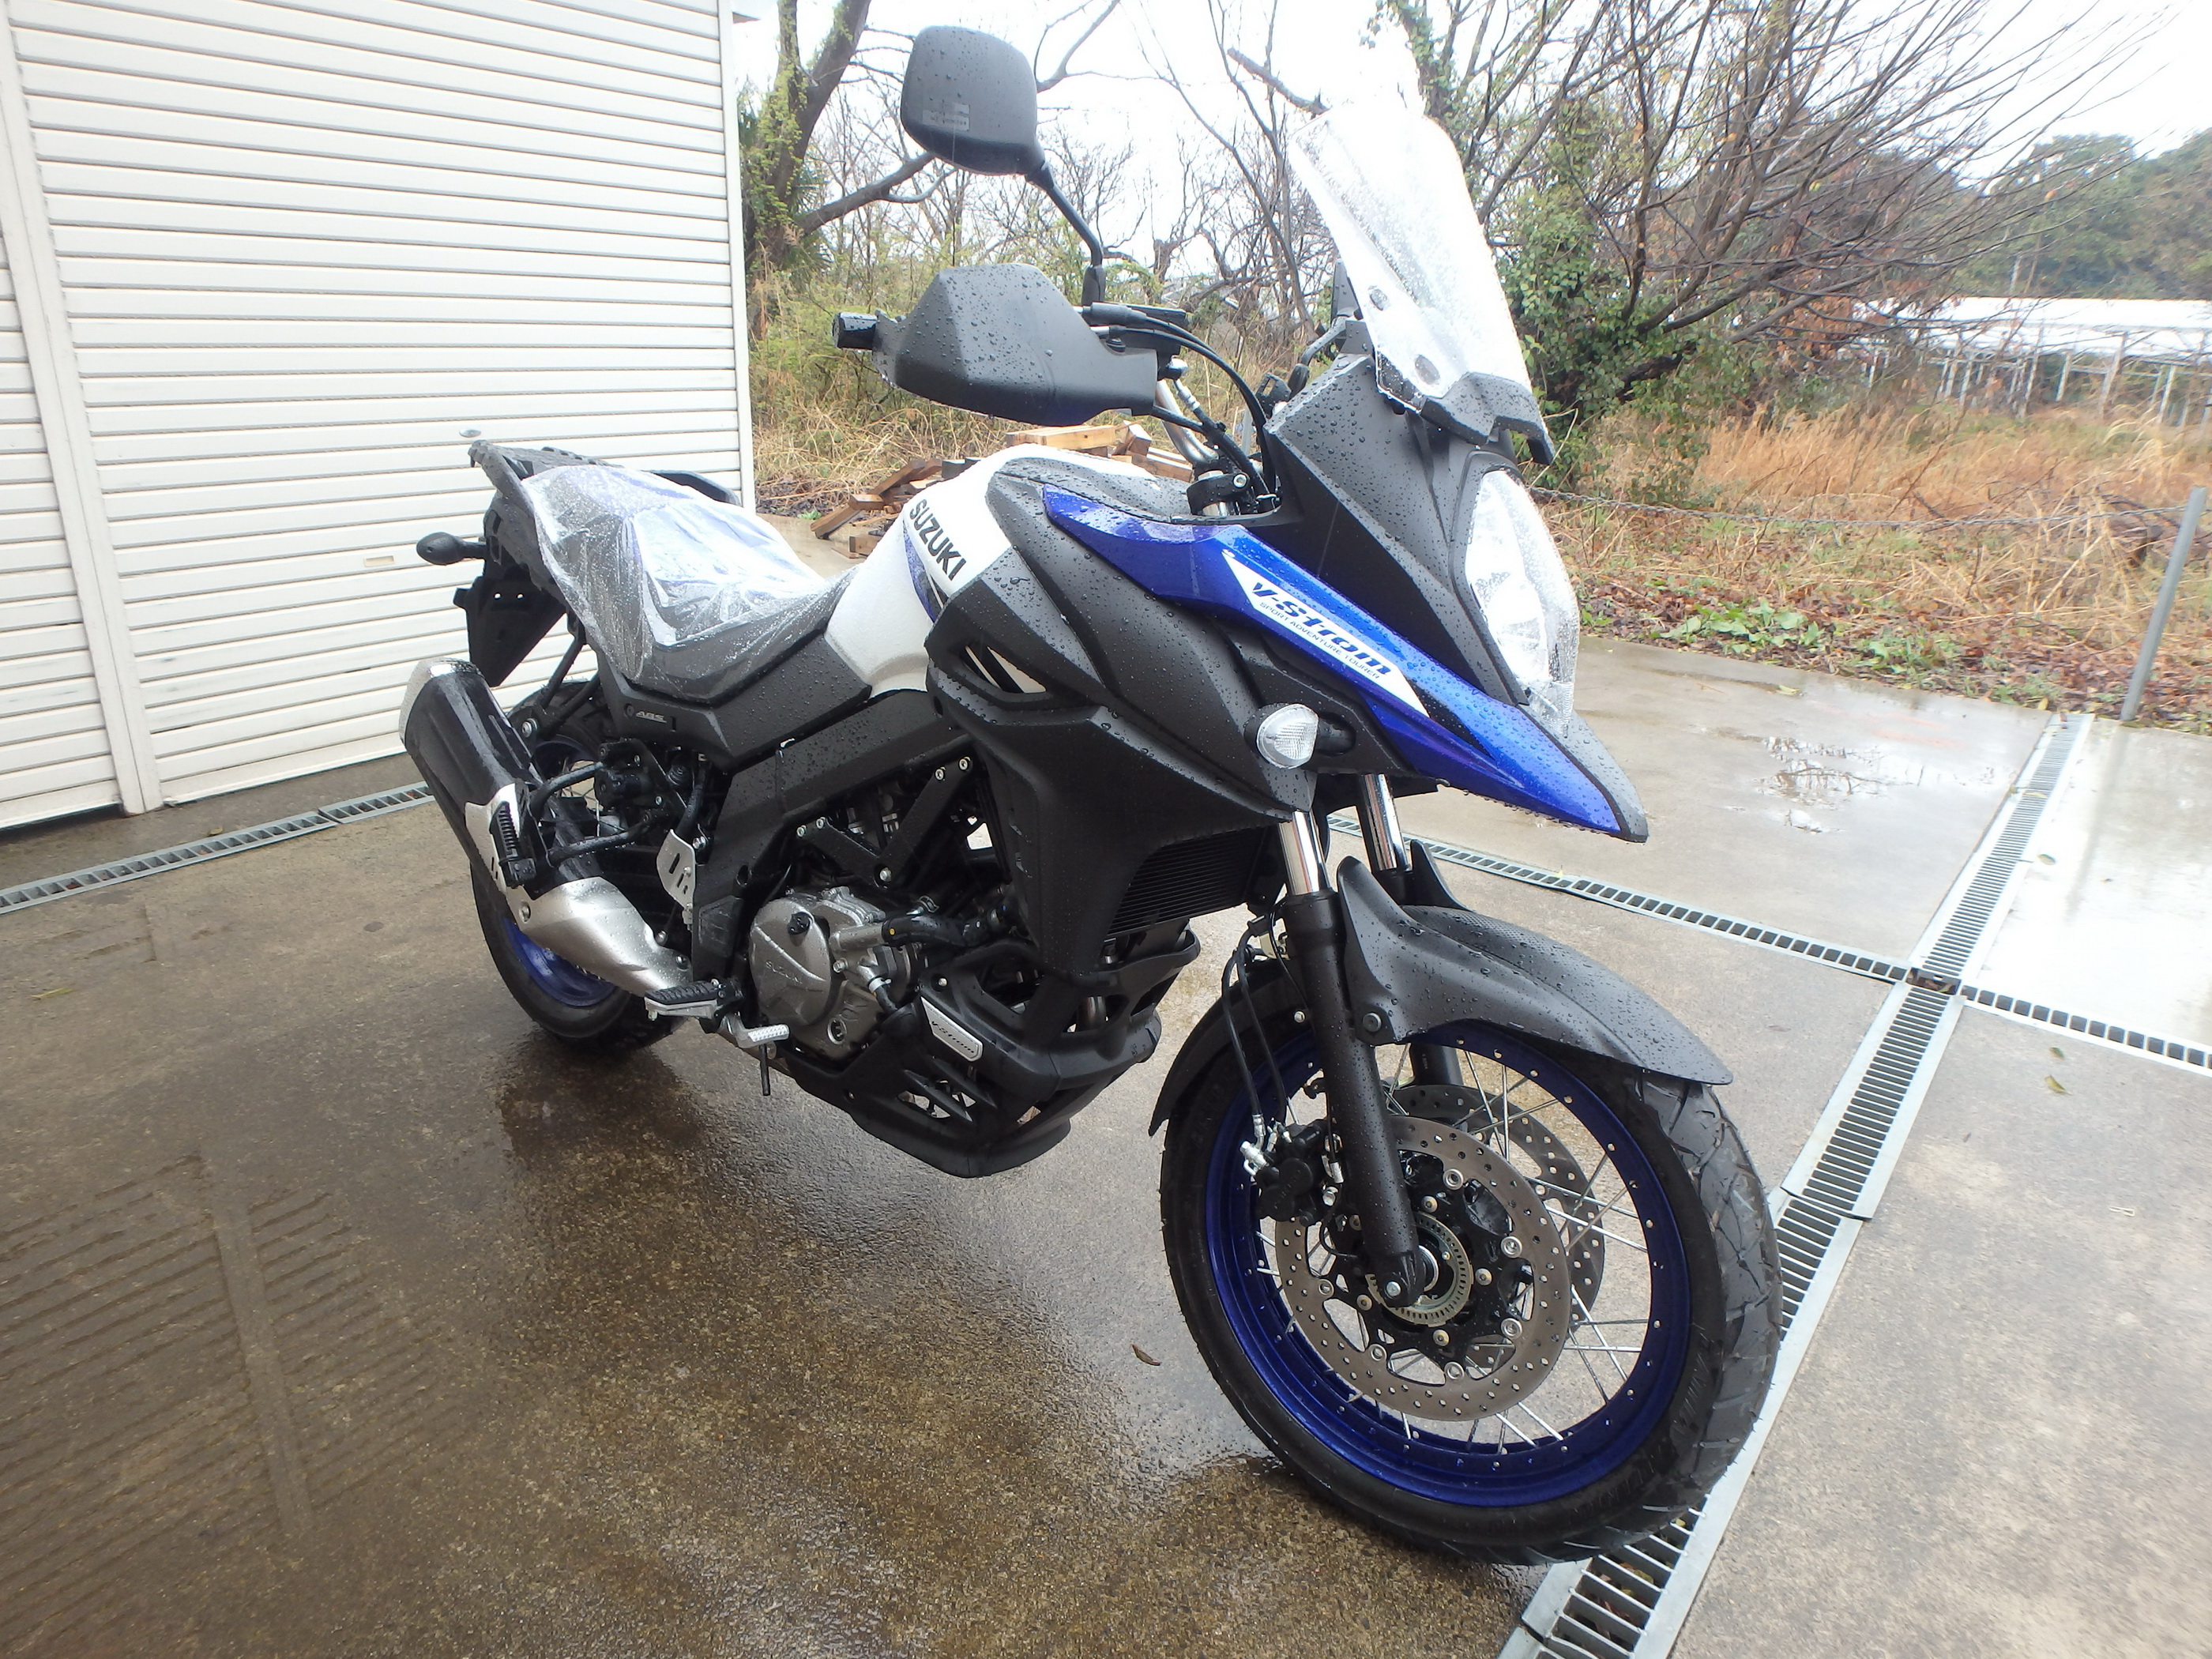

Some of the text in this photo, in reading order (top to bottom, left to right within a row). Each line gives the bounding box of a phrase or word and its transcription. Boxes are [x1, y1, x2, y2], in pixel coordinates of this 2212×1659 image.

[909, 498, 967, 581] SUZUKI
[1251, 582, 1392, 675] V-Strom
[1259, 602, 1380, 679] SPORT ADVENTURE TOURER
